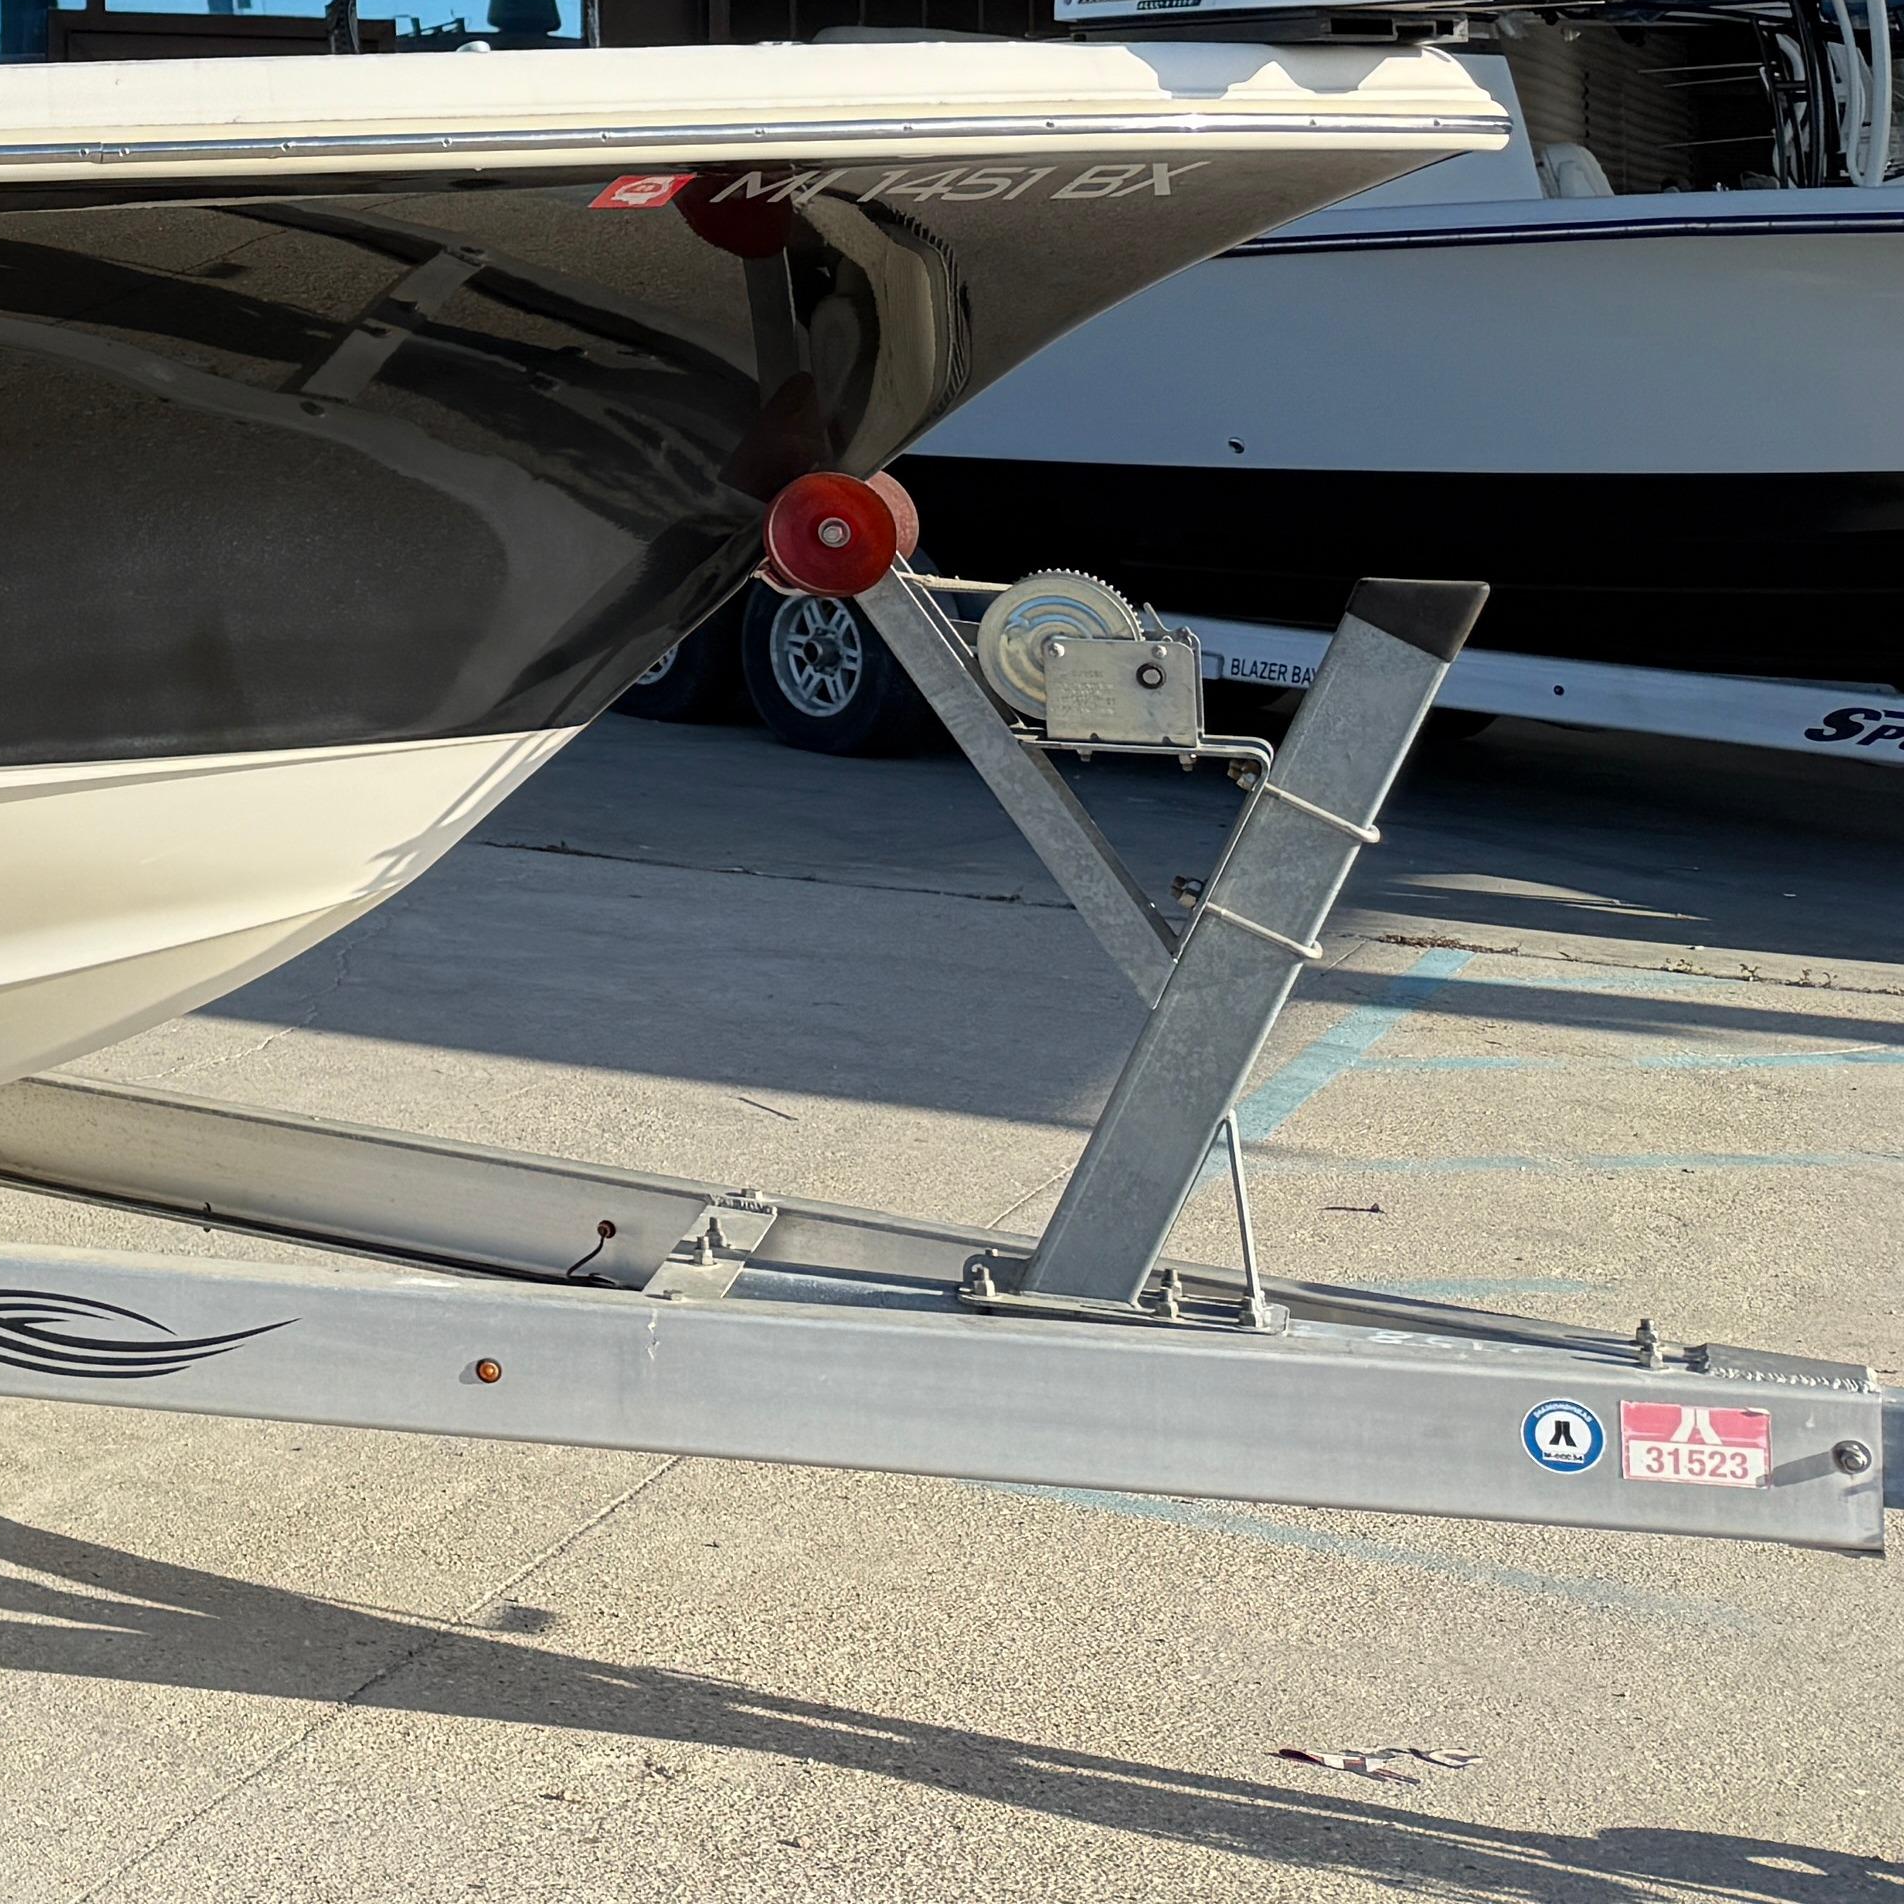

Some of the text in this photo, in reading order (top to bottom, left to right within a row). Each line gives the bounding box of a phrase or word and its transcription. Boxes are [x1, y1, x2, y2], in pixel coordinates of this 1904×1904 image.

[709, 161, 1212, 204] MI 1451 BX
[1230, 658, 1287, 682] BLAZER
[1804, 707, 1904, 752] SP
[1645, 1446, 1749, 1480] 31523
